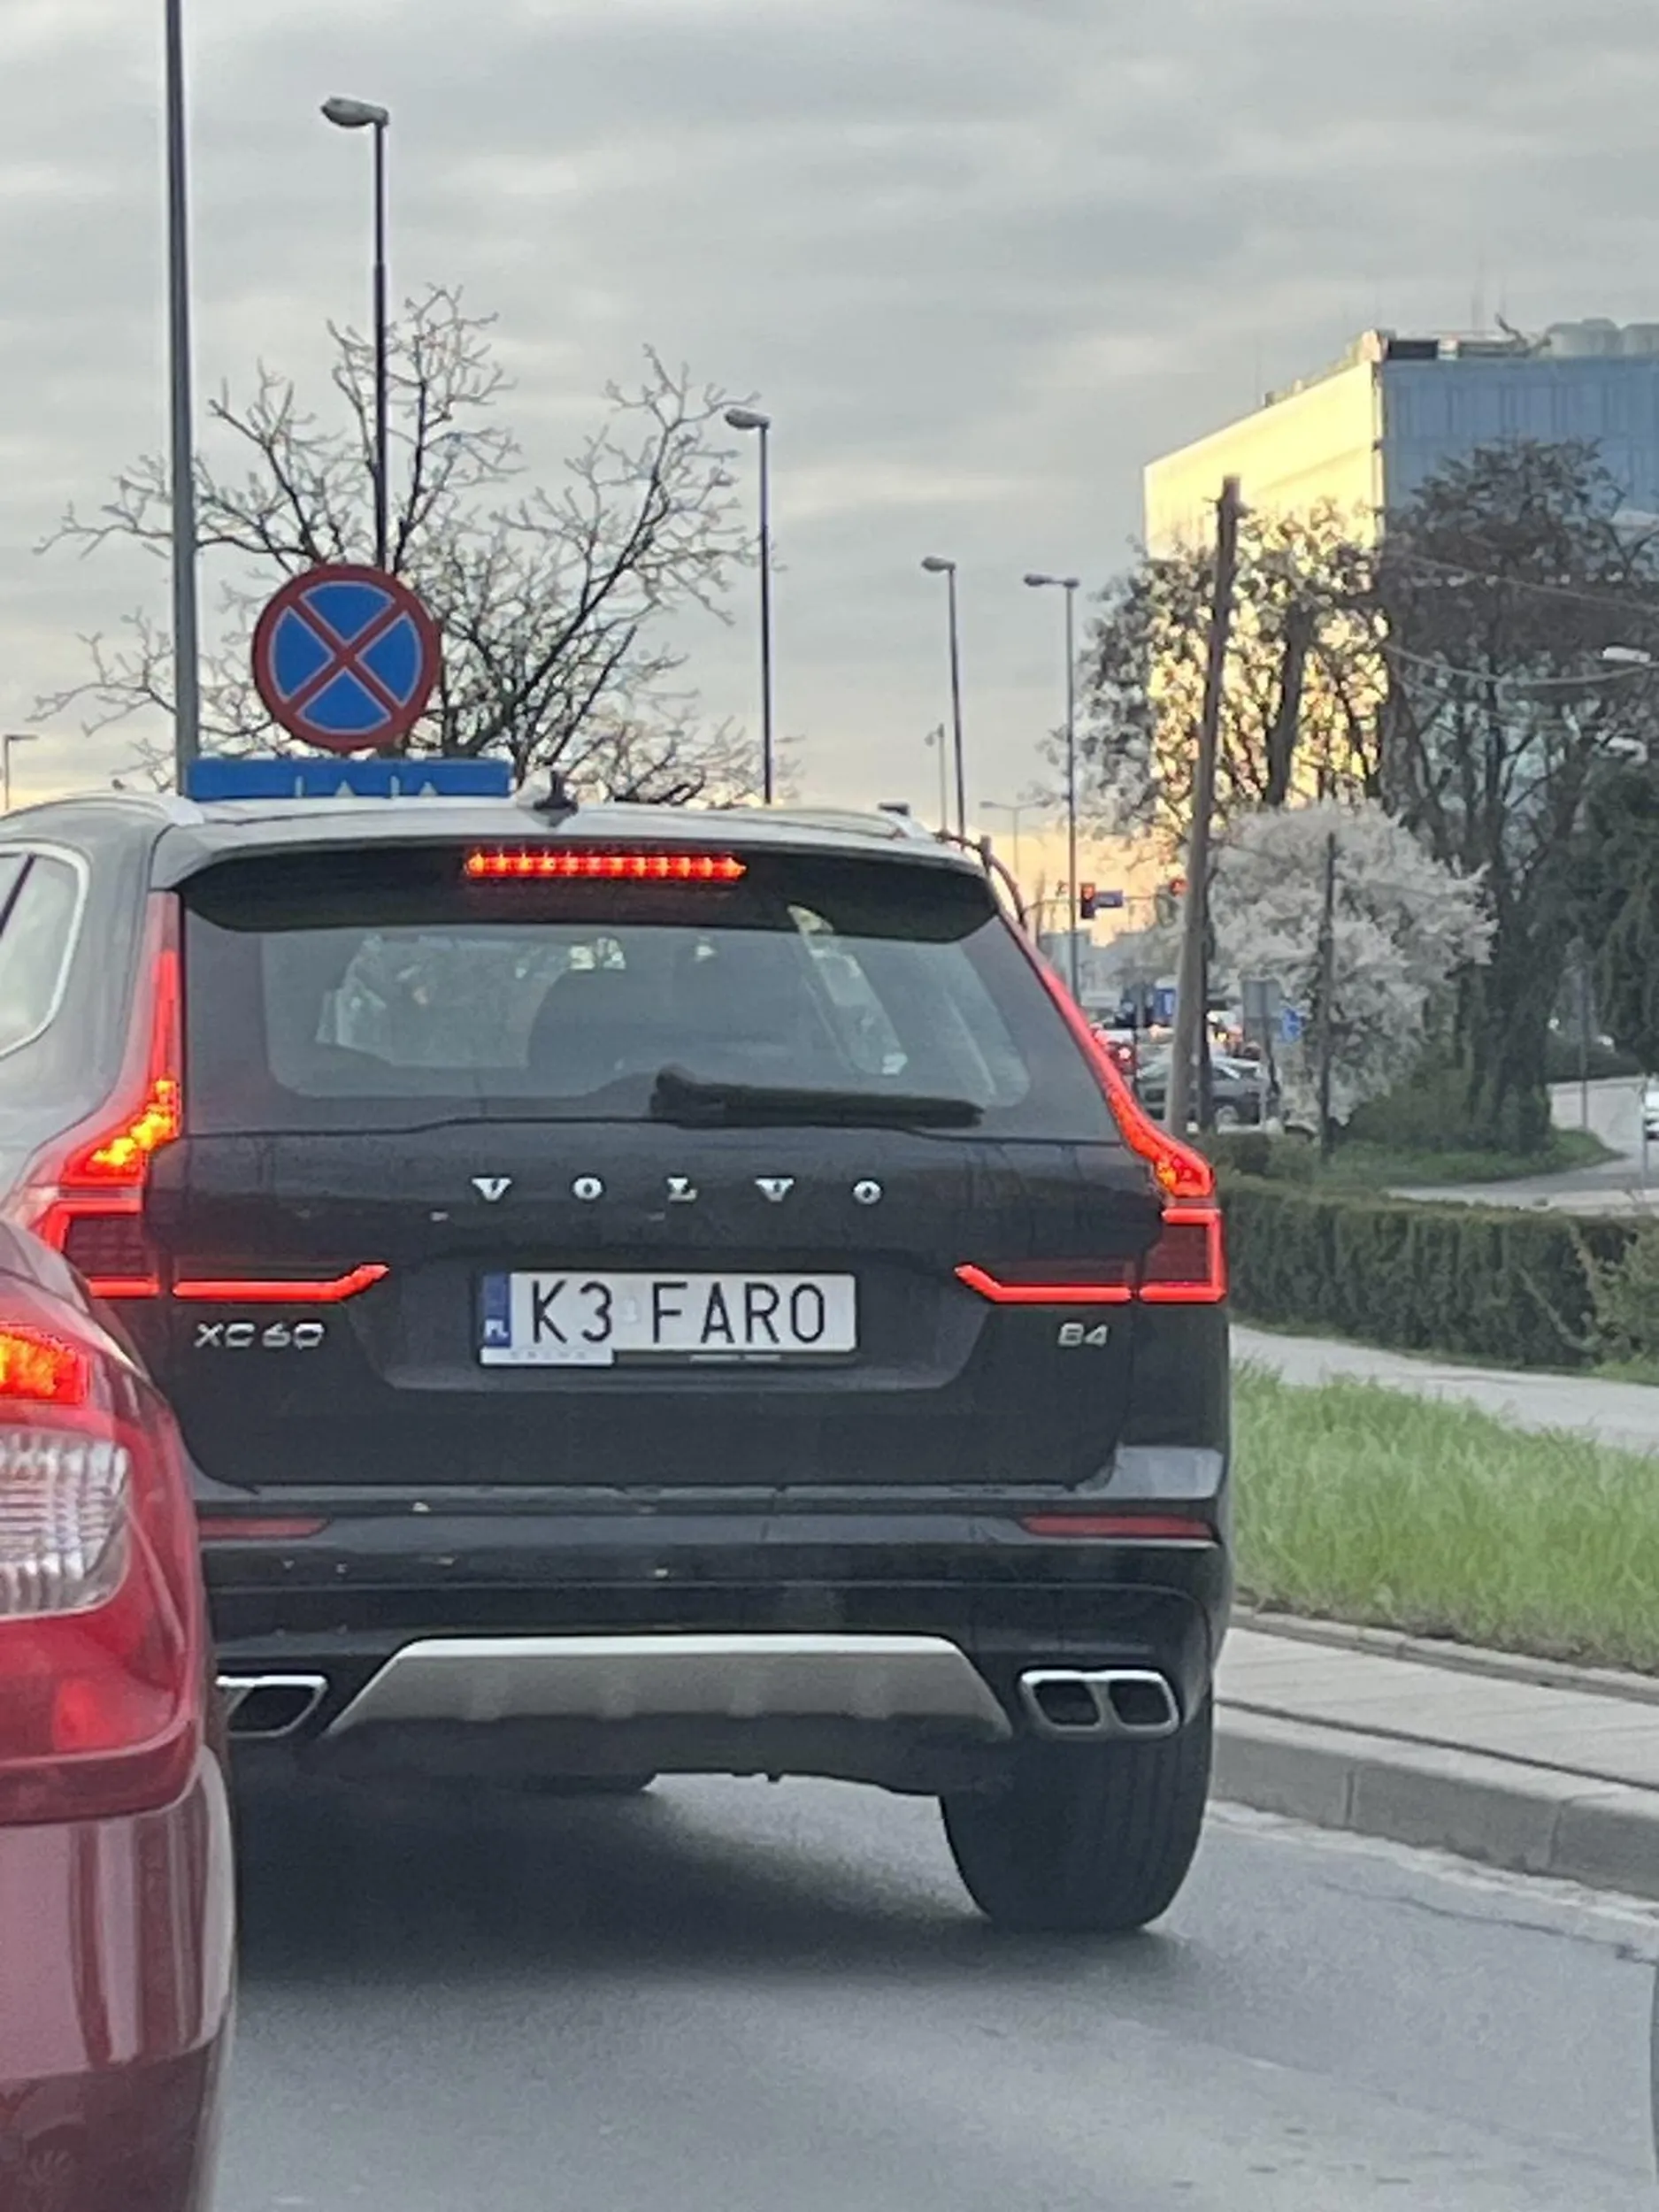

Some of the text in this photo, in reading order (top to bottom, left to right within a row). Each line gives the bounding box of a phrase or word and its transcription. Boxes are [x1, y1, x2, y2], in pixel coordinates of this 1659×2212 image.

[472, 1177, 882, 1204] VOLVO
[533, 1279, 825, 1343] K3 FARO
